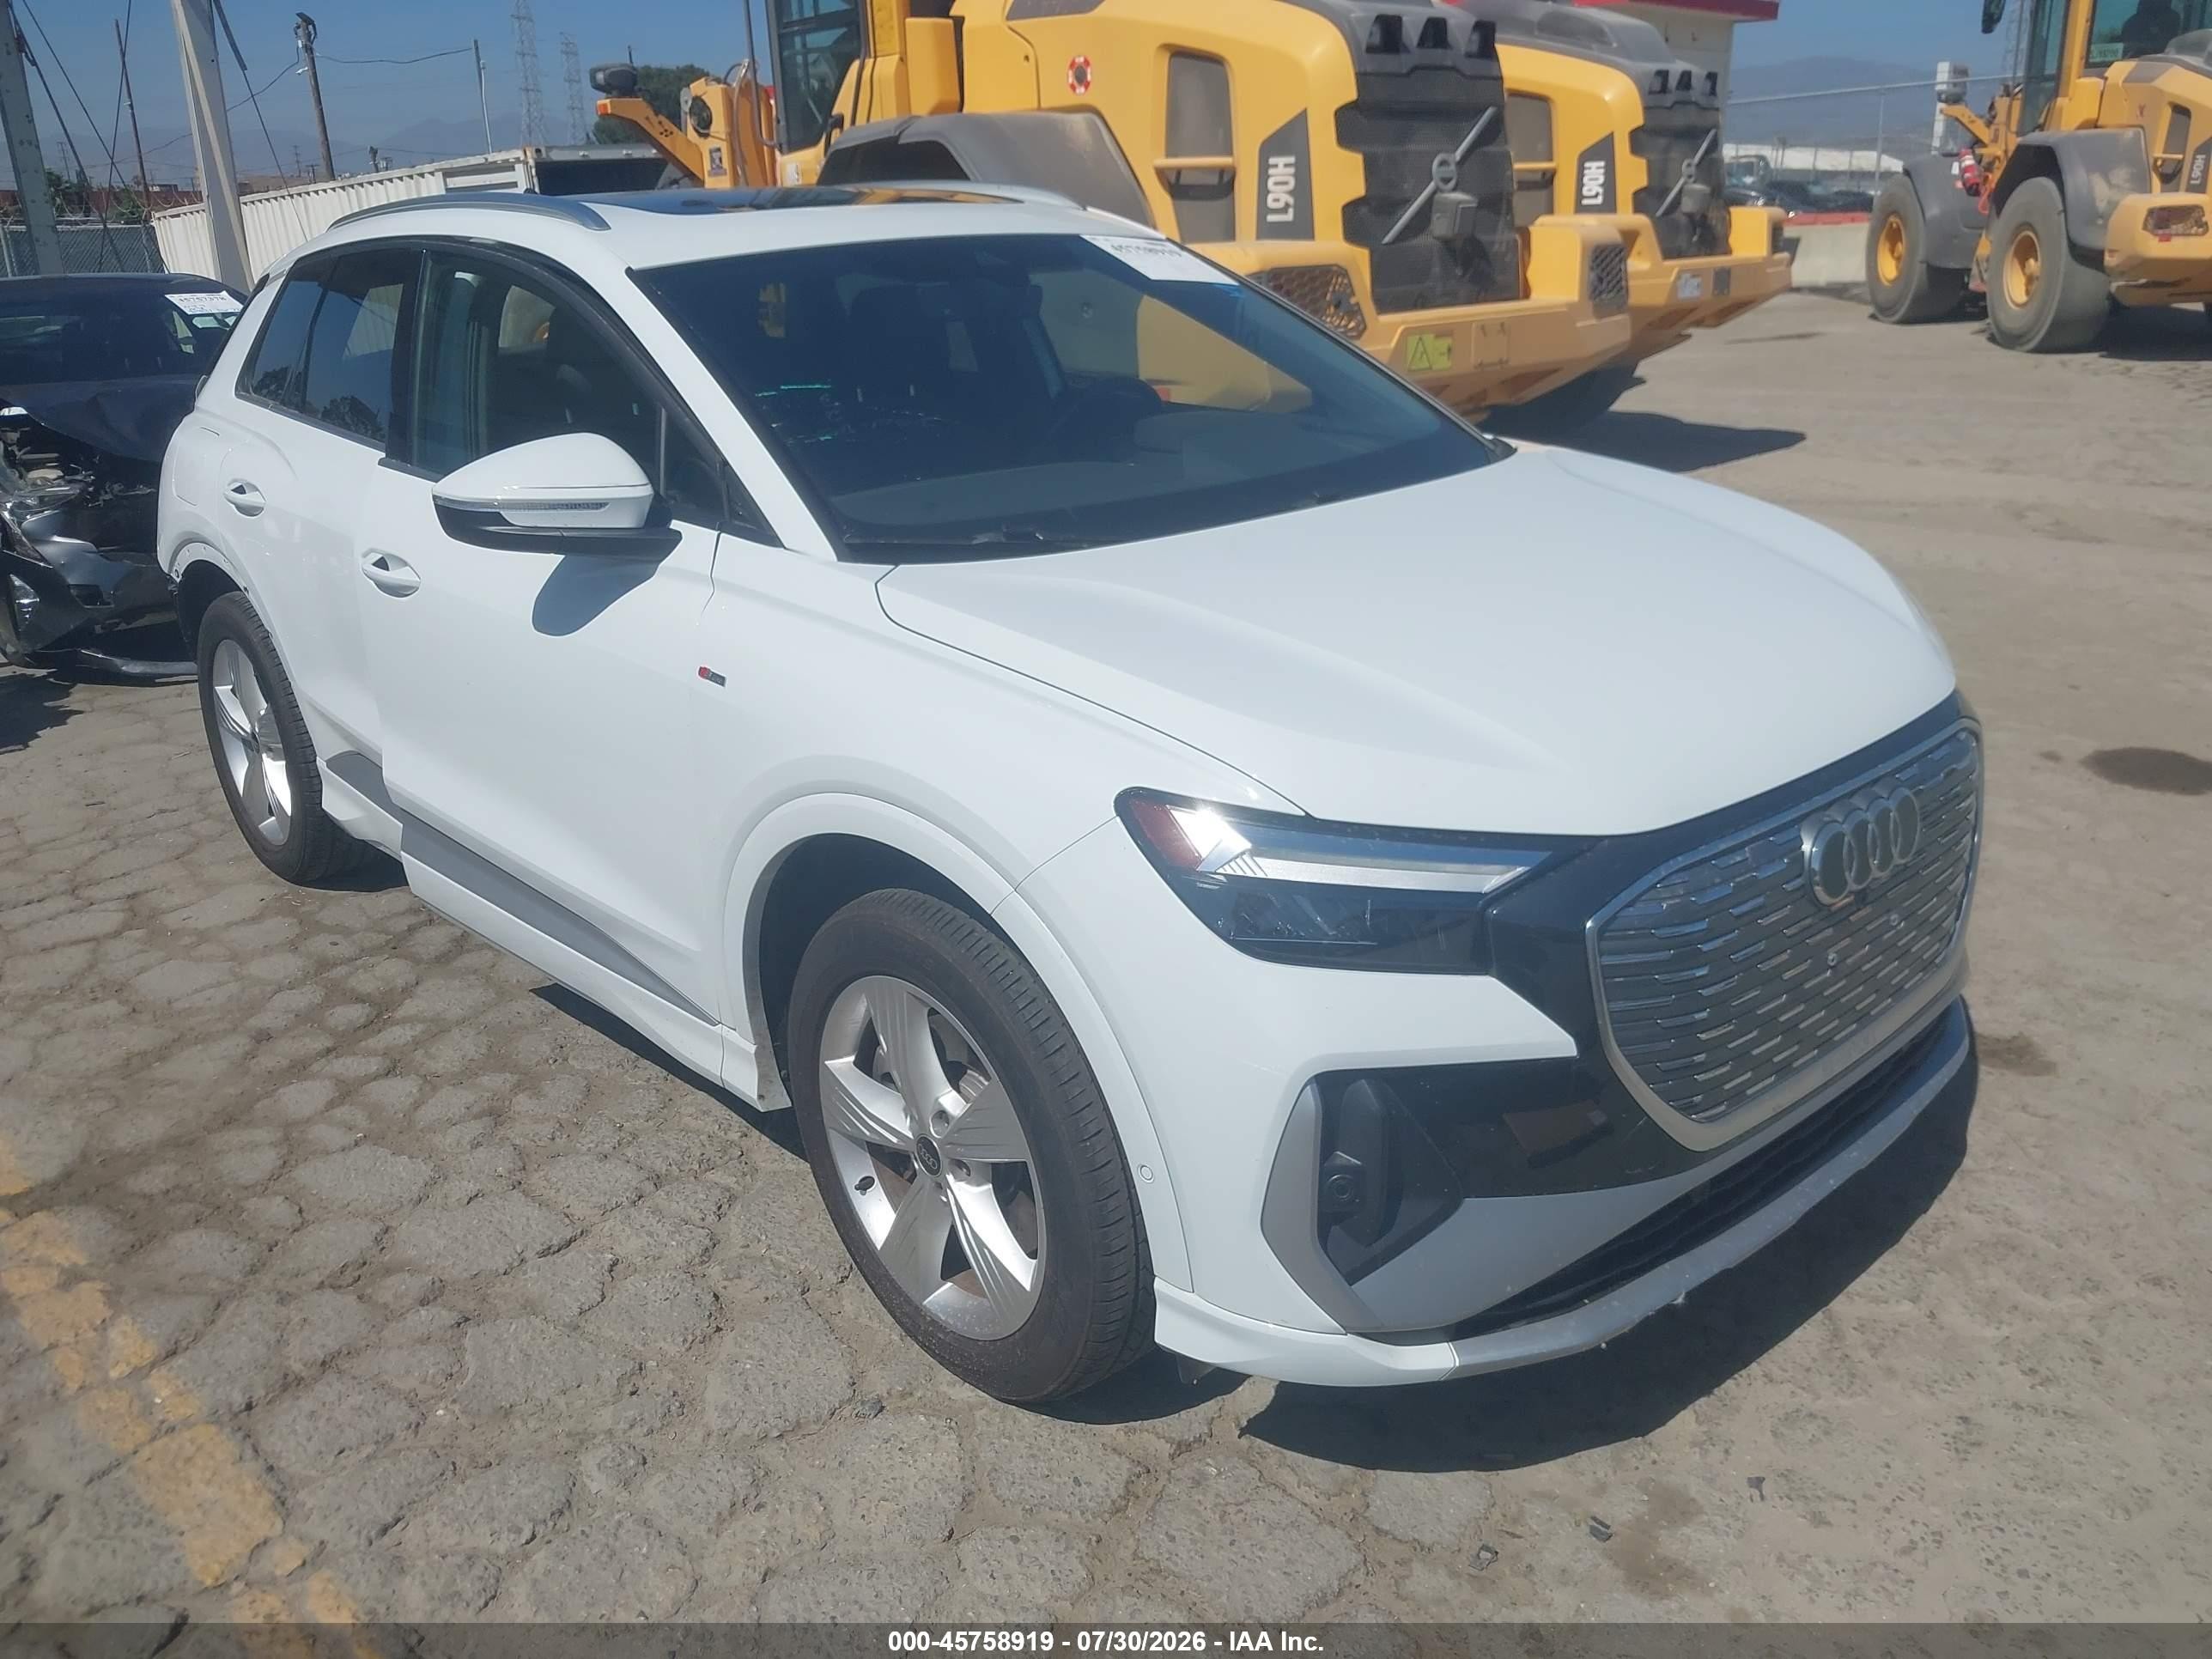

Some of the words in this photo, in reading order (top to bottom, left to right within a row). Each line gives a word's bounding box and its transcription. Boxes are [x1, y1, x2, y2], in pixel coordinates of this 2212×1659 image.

[1267, 156, 1296, 222] L90H
[1581, 161, 1606, 205] L90H
[2190, 155, 2206, 184] L90H
